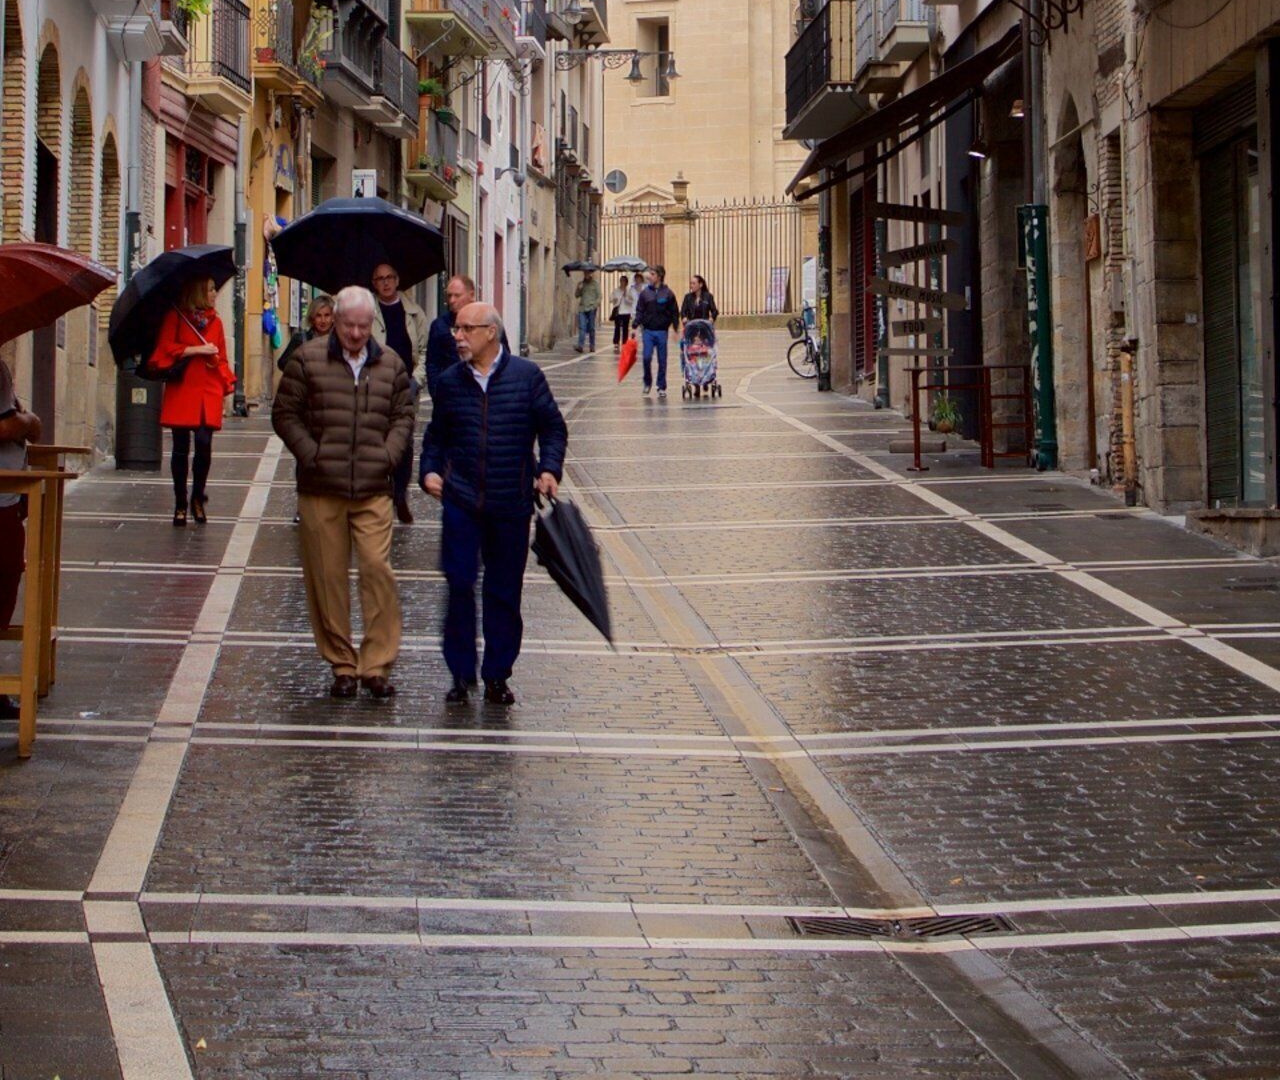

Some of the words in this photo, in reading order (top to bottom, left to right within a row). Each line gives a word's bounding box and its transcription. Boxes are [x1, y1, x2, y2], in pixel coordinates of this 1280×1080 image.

[888, 286, 910, 298] LIVE
[918, 290, 943, 304] MUSIC
[903, 321, 925, 332] FOOD
